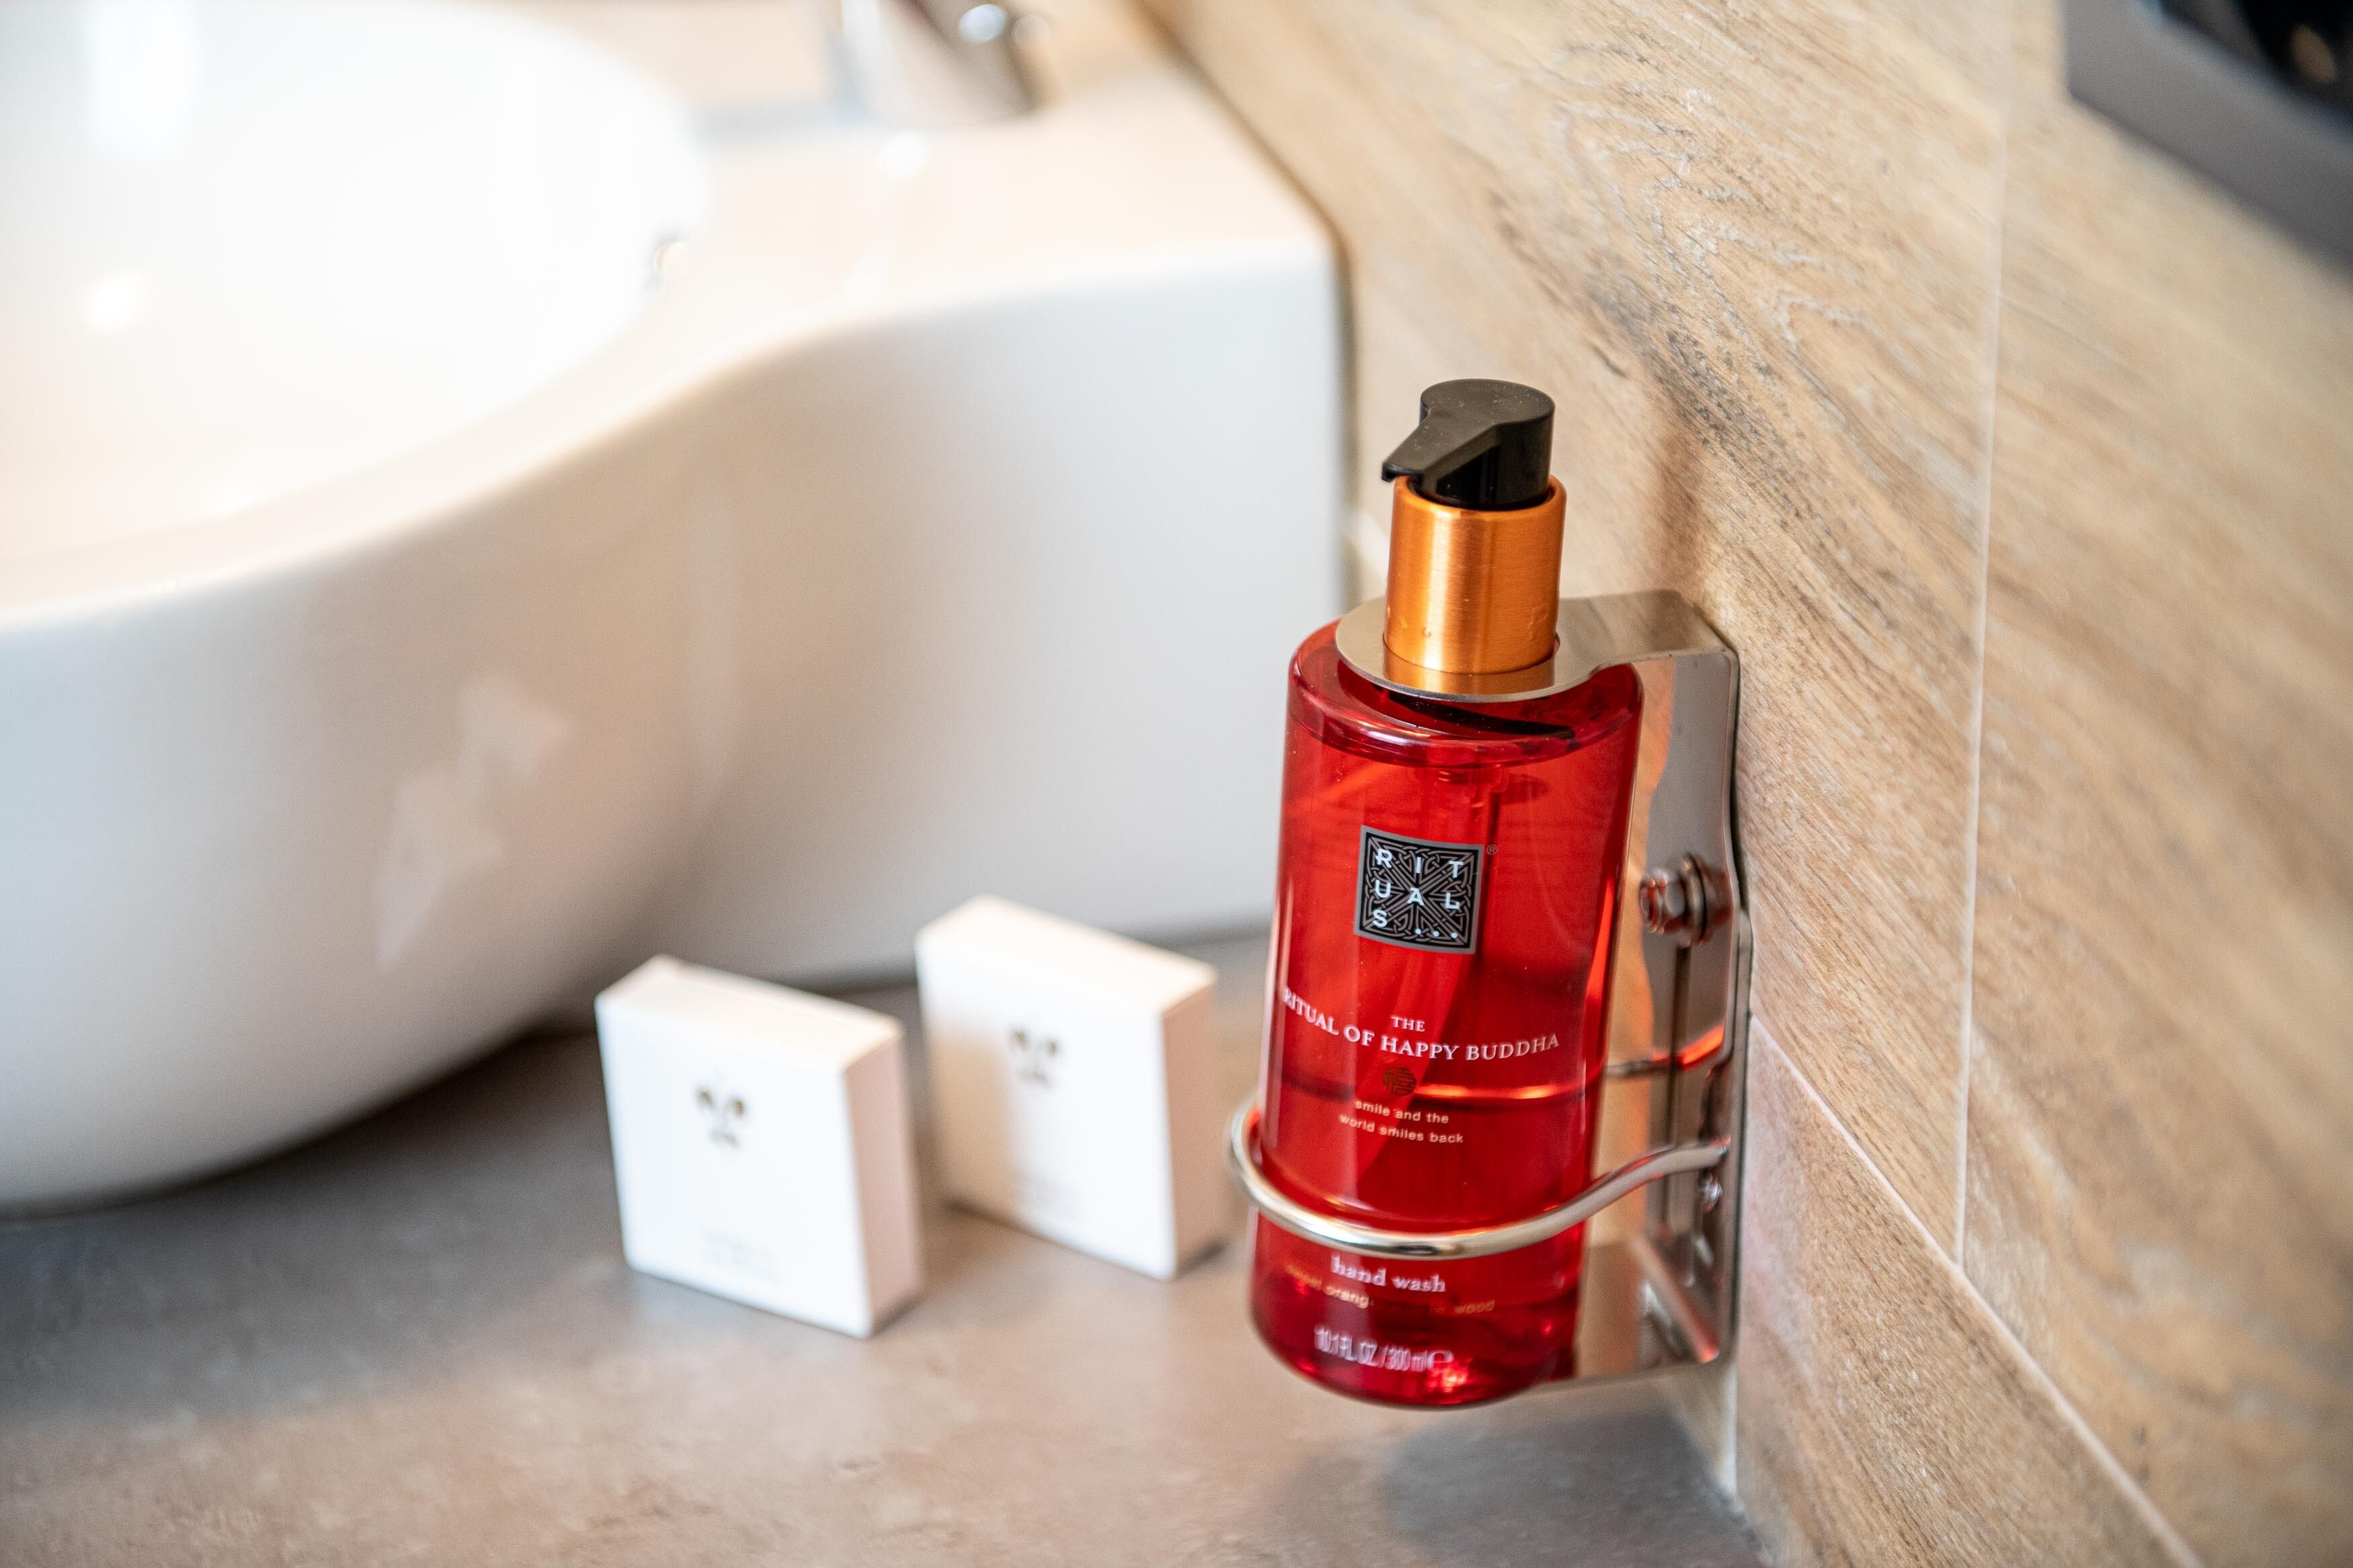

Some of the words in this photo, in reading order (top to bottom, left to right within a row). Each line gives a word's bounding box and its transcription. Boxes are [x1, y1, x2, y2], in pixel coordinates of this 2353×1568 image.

[1282, 985, 1339, 1035] RITUAL
[1343, 1024, 1375, 1047] OF
[1381, 1036, 1460, 1061] HAPPY
[1466, 1033, 1560, 1061] BUDDHA
[1391, 1015, 1425, 1032] THE
[1354, 1100, 1391, 1117] smile
[1395, 1109, 1421, 1122] and
[1427, 1112, 1449, 1123] the
[1340, 1112, 1375, 1132] world
[1378, 1124, 1424, 1141] smiles
[1429, 1131, 1464, 1143] back
[1330, 1255, 1386, 1286] hand
[1392, 1274, 1445, 1292] wash
[1324, 1285, 1374, 1309] orang
